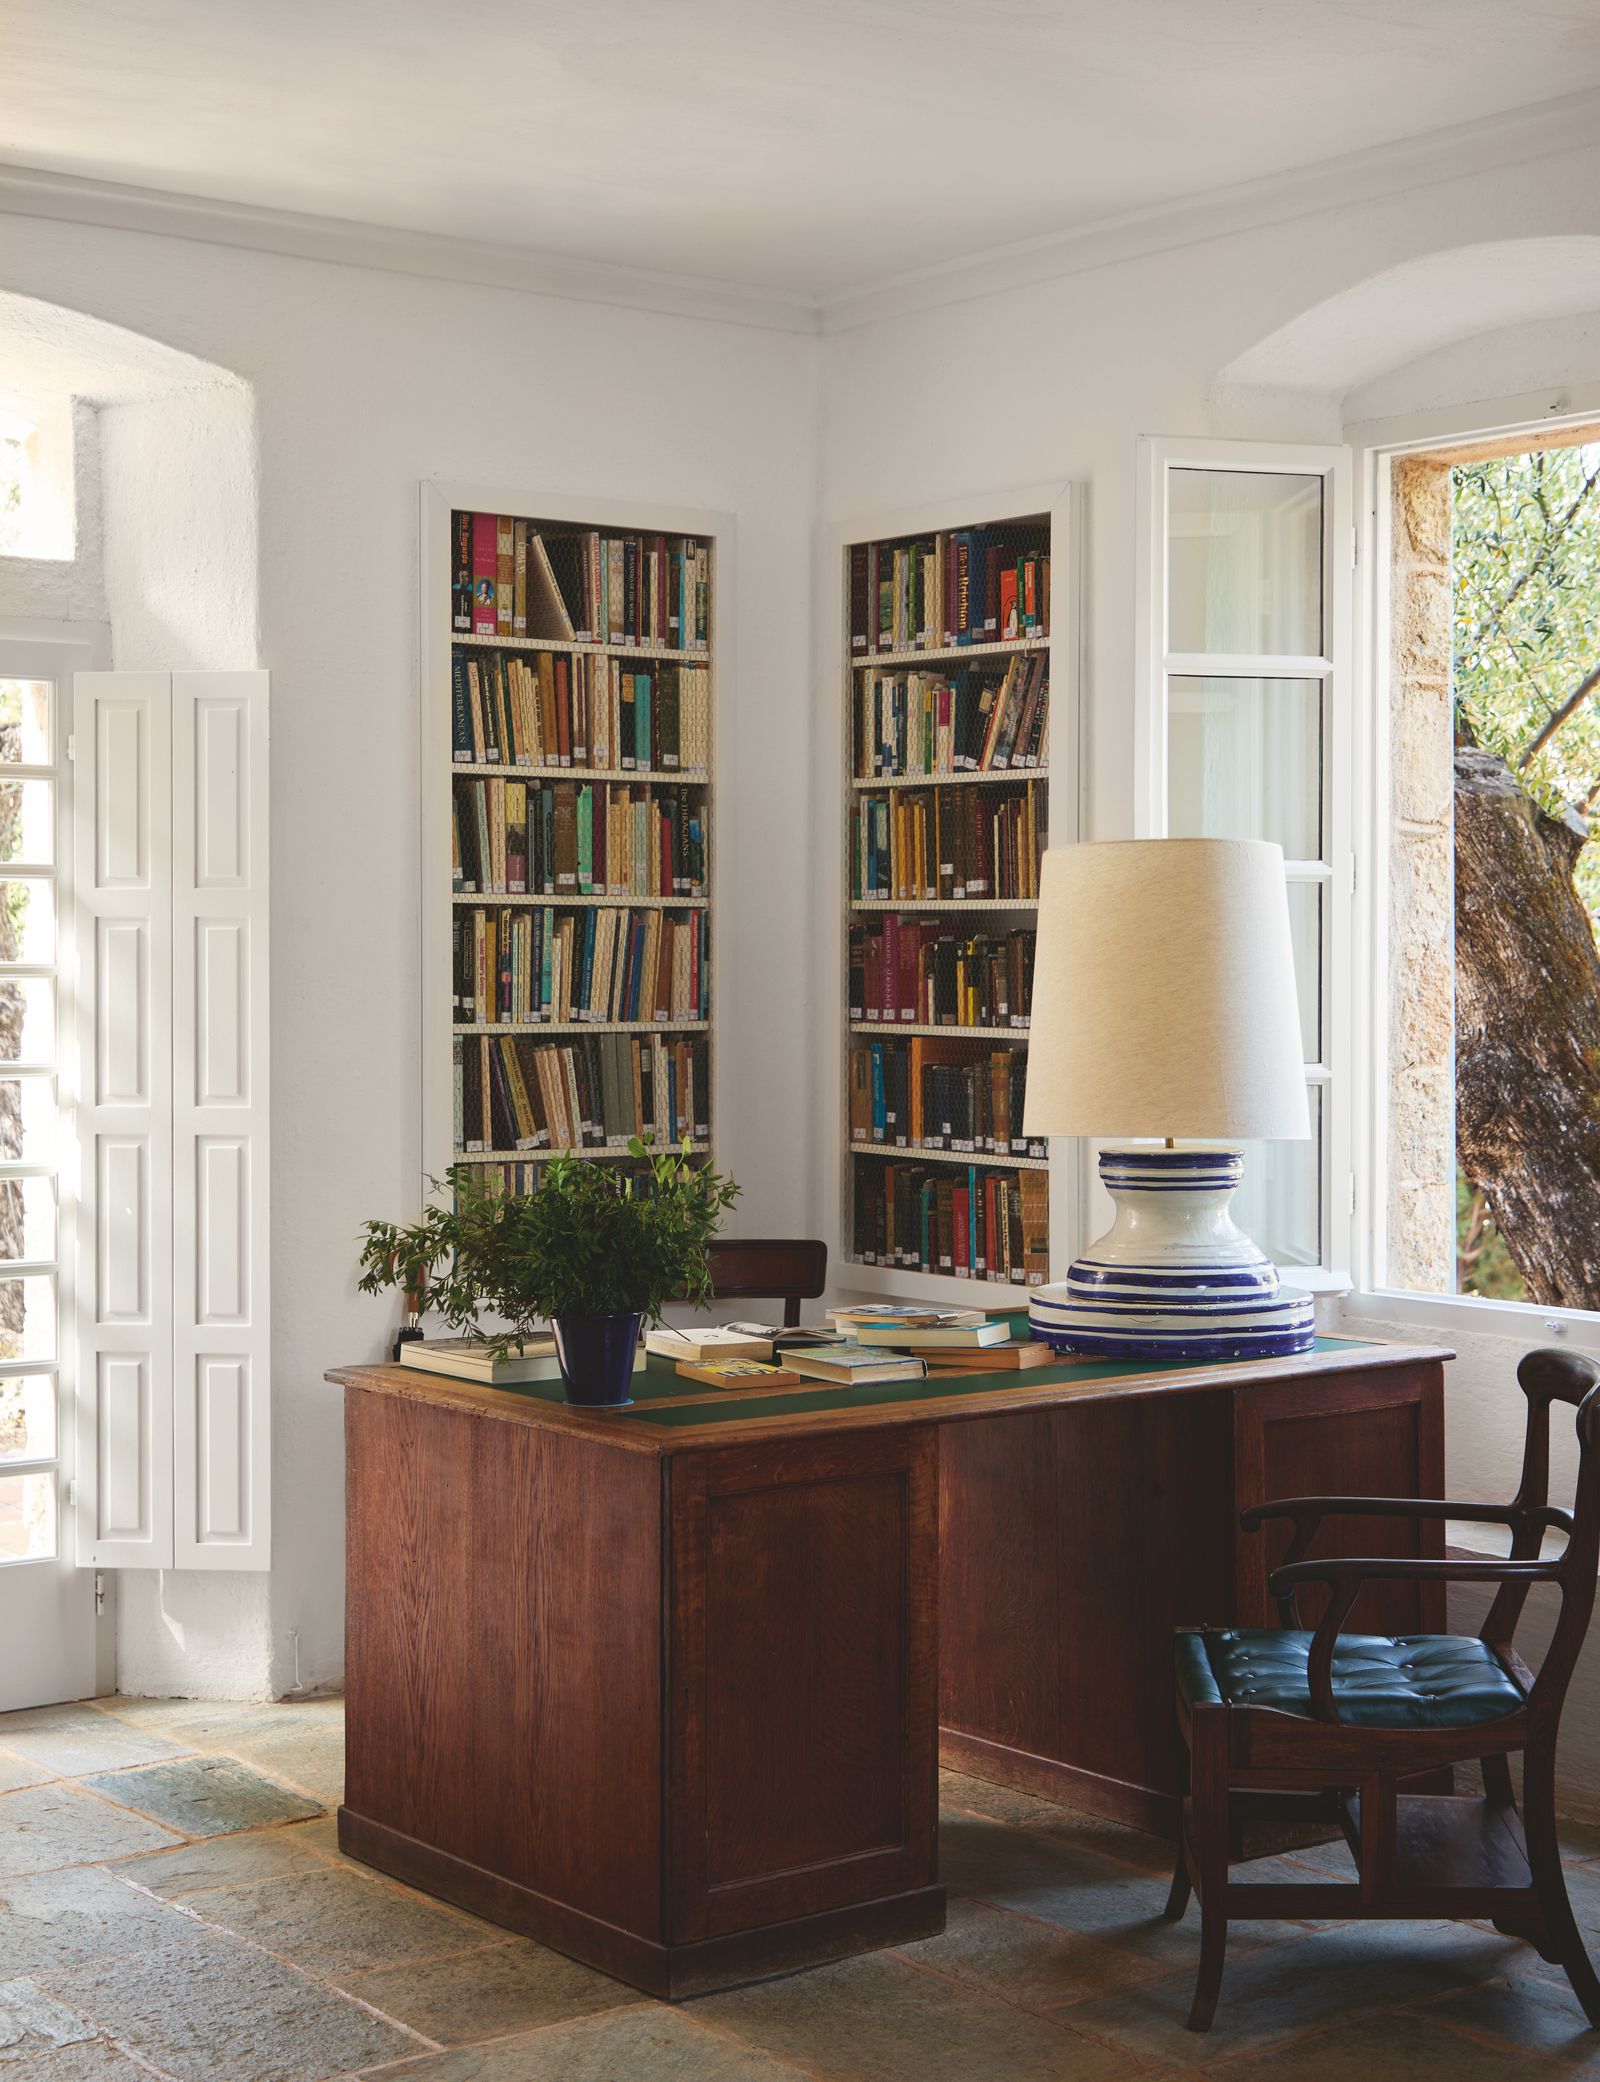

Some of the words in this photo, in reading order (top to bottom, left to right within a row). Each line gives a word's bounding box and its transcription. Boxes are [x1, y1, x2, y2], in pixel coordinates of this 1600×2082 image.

[460, 532, 469, 564] Bogarde
[958, 577, 969, 629] Brighton
[454, 666, 466, 743] MEDITERRANEAN
